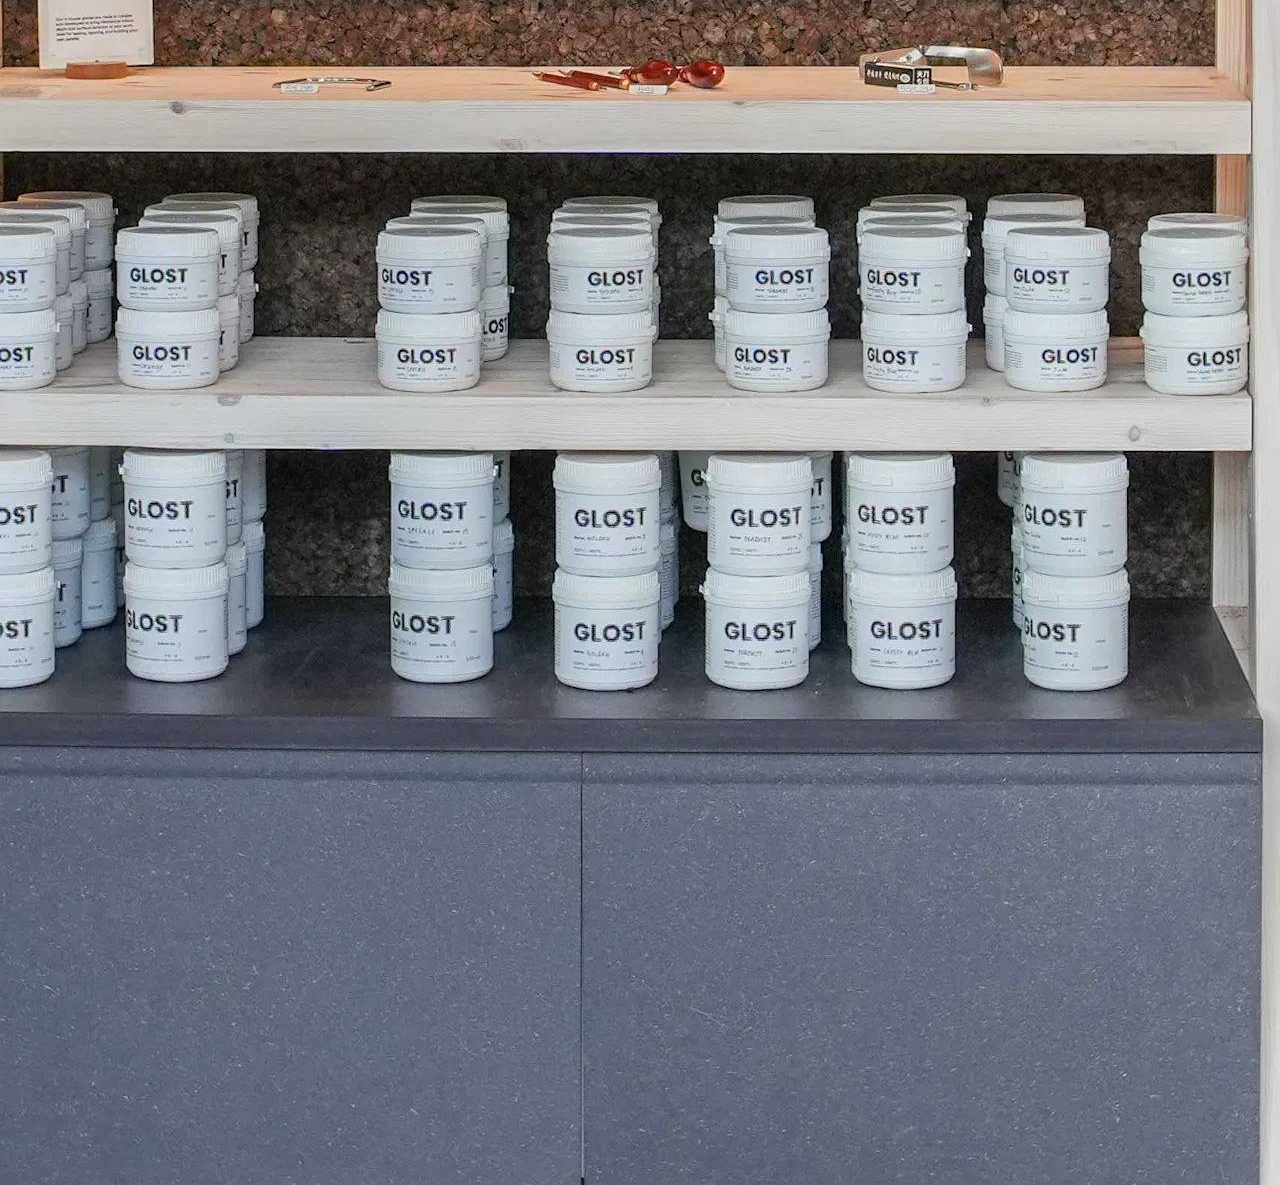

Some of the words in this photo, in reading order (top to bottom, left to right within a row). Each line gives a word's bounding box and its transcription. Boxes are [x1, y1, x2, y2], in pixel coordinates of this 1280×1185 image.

[130, 268, 187, 283] GLOST
[382, 268, 432, 285] GLOST
[588, 269, 643, 286] GLOST
[755, 269, 813, 285] GLOST
[867, 269, 921, 287] GLOST
[1014, 268, 1069, 285] GLOST
[1173, 271, 1231, 287] GLOST
[483, 317, 508, 335] LOST
[133, 346, 191, 361] GLOST
[397, 349, 456, 364] GLOST
[576, 349, 635, 364] GLOST
[735, 347, 790, 364] GLOST
[868, 347, 918, 365] GLOST
[1042, 347, 1097, 363] GLOST
[1188, 348, 1241, 366] GLOST
[128, 498, 193, 520] GLOST
[398, 500, 467, 521] GLOST
[575, 507, 646, 528] GLOST
[731, 507, 801, 527] GLOST
[858, 505, 928, 525] GLOST
[1025, 504, 1086, 527] GLOST
[128, 611, 182, 633] GLOST
[393, 611, 455, 634] GLOST
[725, 621, 796, 641] GLOST
[871, 619, 942, 640] GLOST
[1025, 619, 1080, 642] GLOST
[574, 621, 645, 642] GLOST
